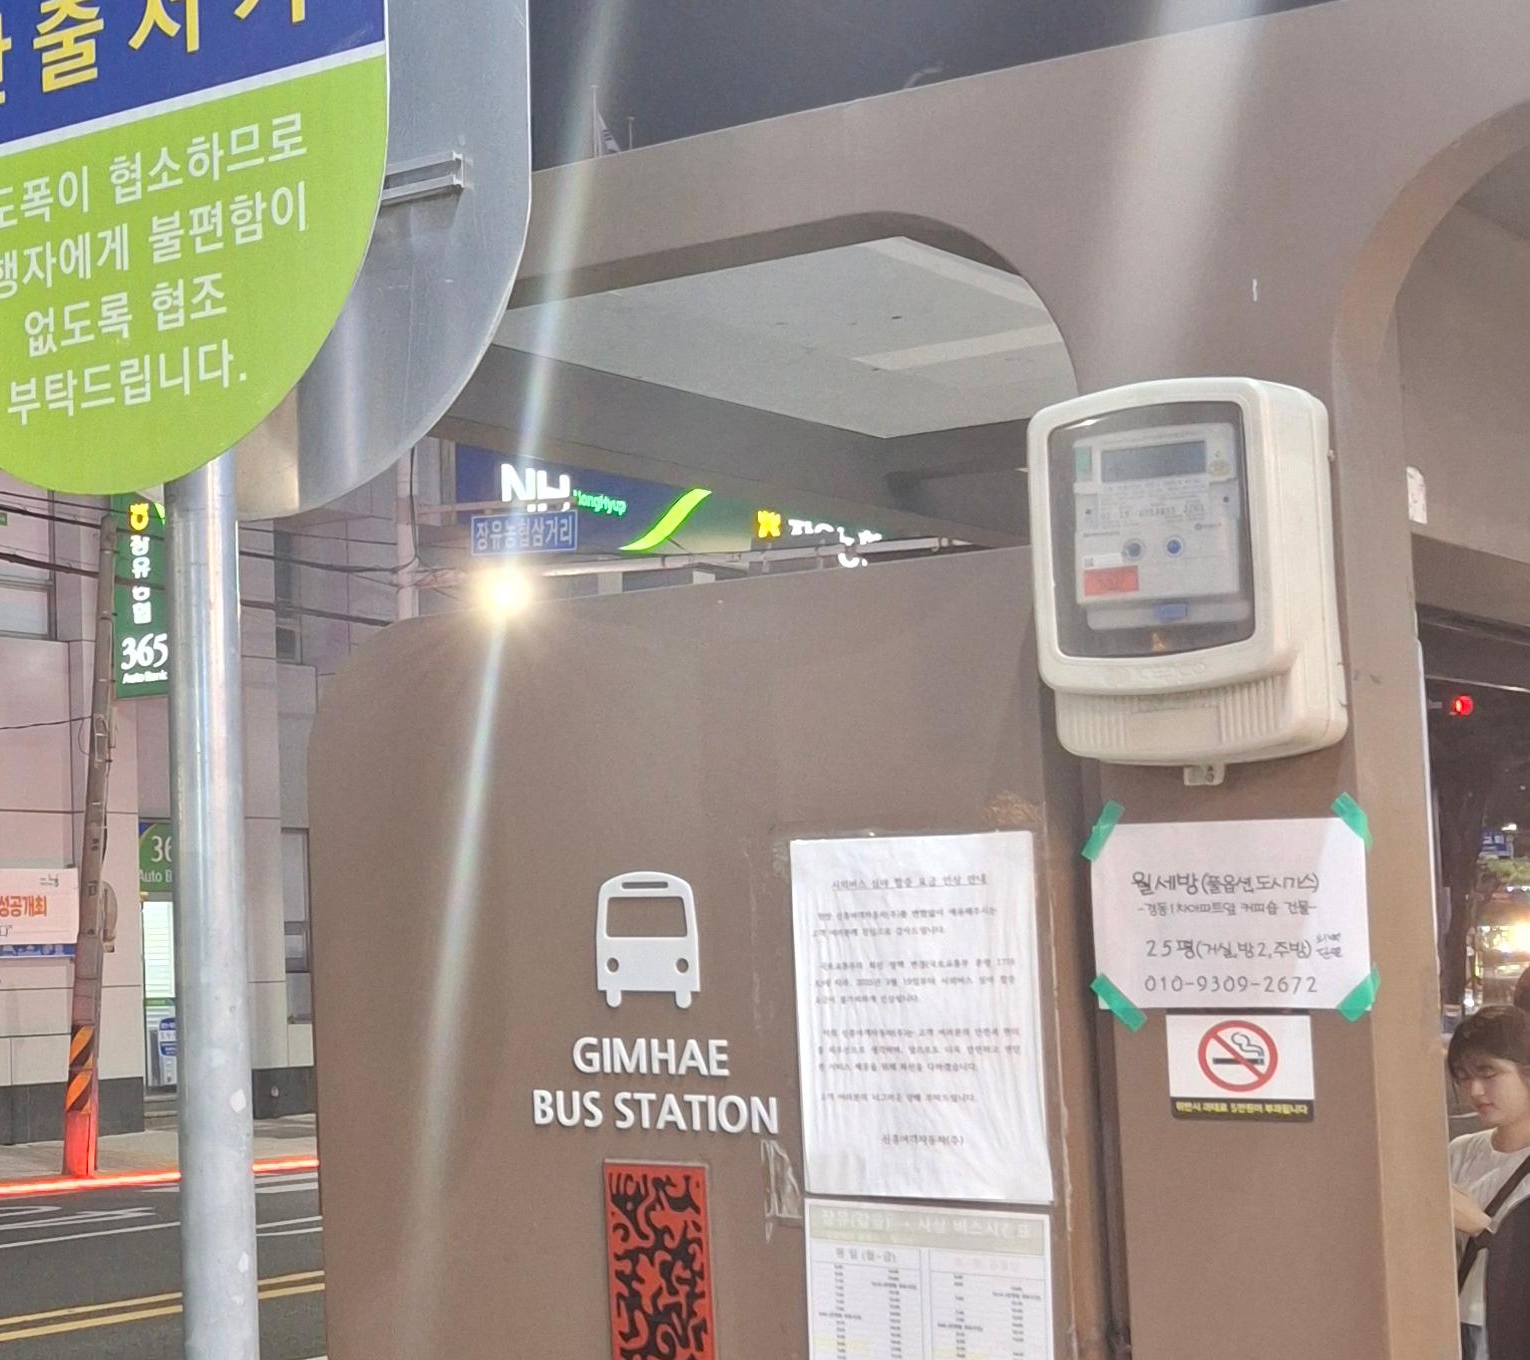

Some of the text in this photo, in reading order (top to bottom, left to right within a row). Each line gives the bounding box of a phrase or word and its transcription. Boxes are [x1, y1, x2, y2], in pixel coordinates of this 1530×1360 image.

[109, 110, 309, 208] 협소하므로
[147, 180, 309, 268] 불편함이
[22, 271, 229, 358] 없도록 협조
[6, 337, 249, 427] 부탁드립니다.
[121, 633, 169, 670] 365
[151, 835, 173, 863] 36
[1144, 975, 1318, 994] 010-9309-2672
[572, 1036, 731, 1077] GIMHAE
[533, 1089, 779, 1134] BUS STATION
